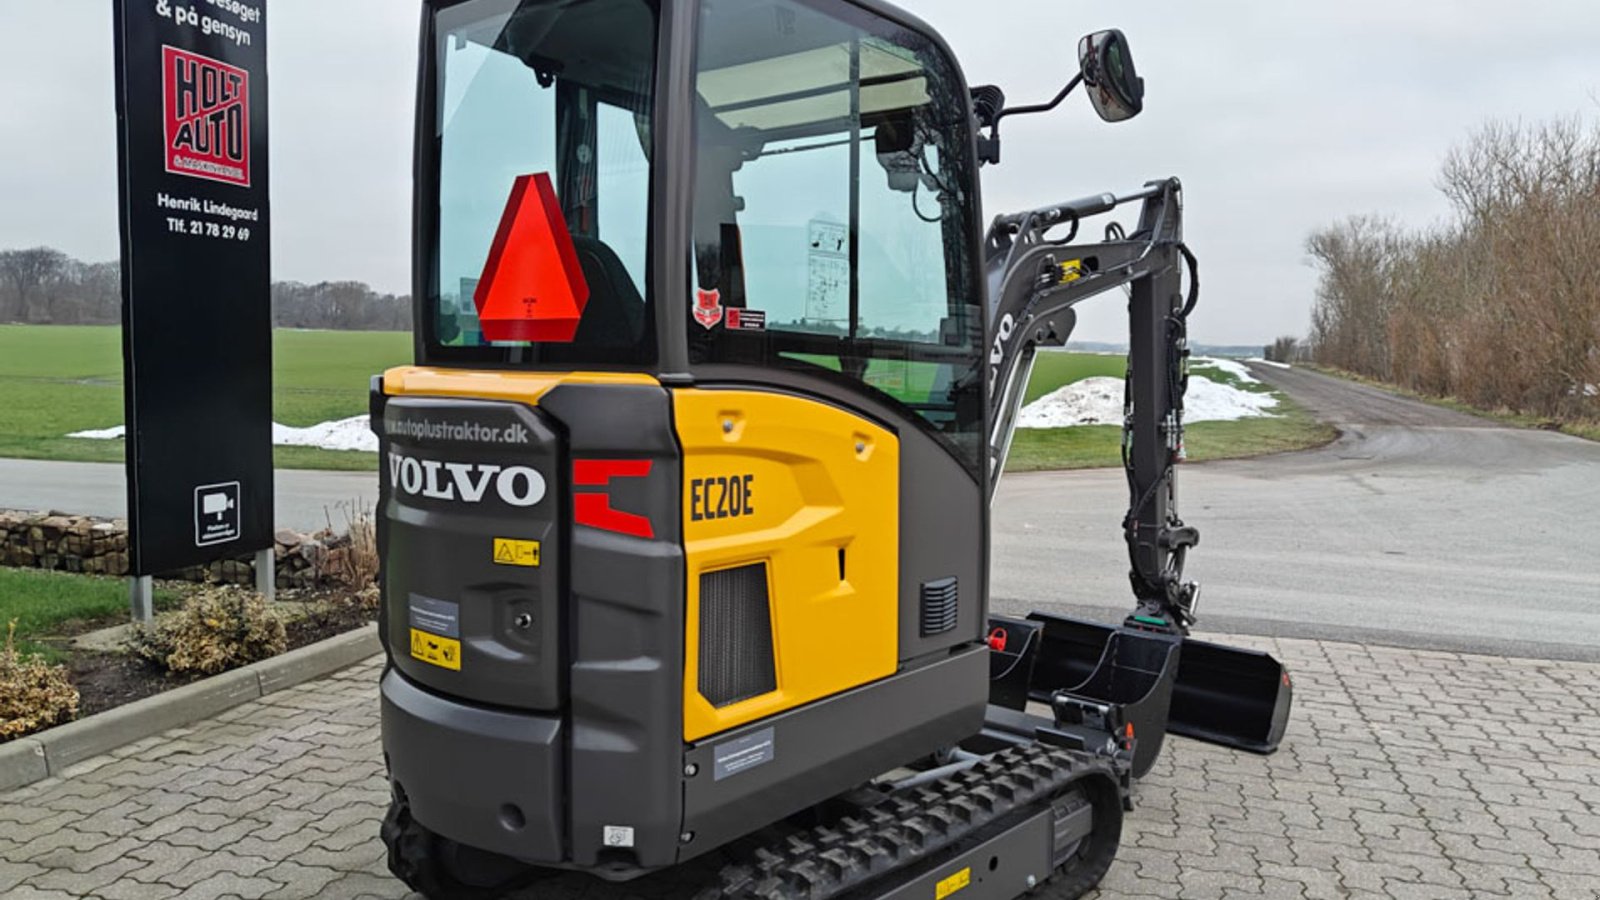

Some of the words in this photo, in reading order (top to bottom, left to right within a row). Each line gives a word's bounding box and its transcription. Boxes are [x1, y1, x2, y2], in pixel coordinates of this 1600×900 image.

[156, 0, 172, 18] &
[175, 6, 198, 26] på
[202, 16, 251, 46] gensyn
[175, 56, 243, 120] HOLT
[173, 102, 243, 161] AUTO
[157, 192, 201, 213] Henrik
[203, 199, 258, 221] Lindegaard
[166, 217, 187, 233] Tlf.
[190, 221, 203, 235] 21
[205, 222, 220, 237] 78
[222, 225, 236, 239] 29
[237, 228, 250, 241] 69
[388, 452, 546, 507] VOLVO
[691, 474, 754, 522] EC20E
